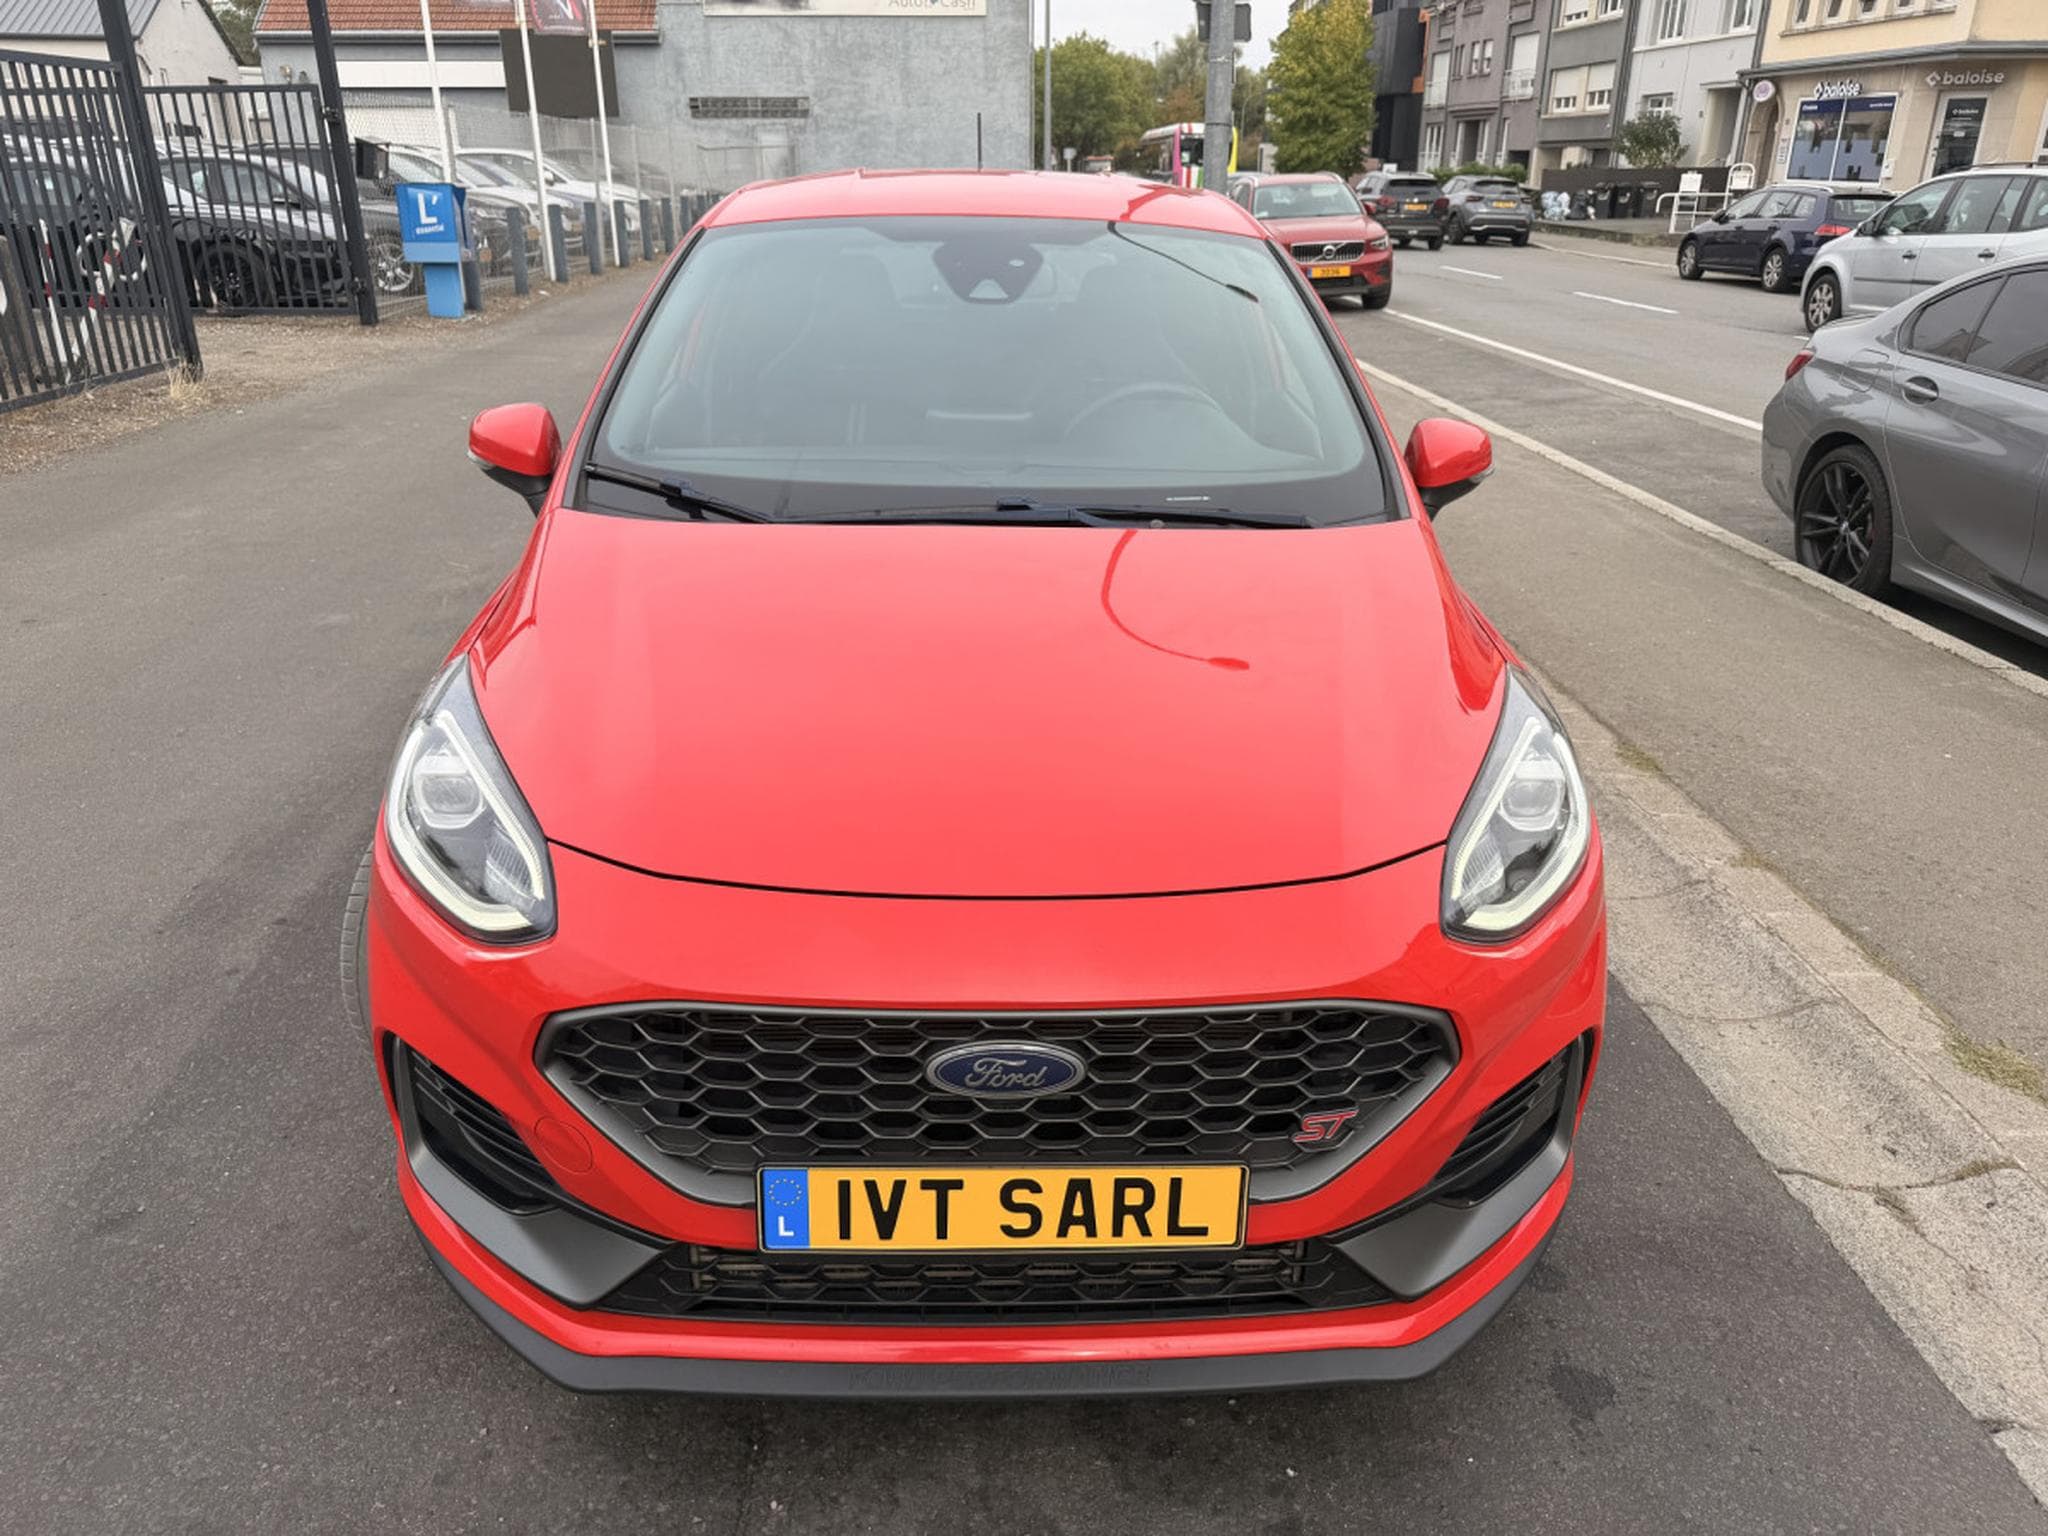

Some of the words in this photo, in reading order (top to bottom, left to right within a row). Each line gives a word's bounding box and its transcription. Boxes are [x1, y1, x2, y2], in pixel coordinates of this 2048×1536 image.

[1943, 69, 2005, 85] baloise
[966, 1057, 1048, 1089] Ford
[1294, 1108, 1360, 1142] ST
[837, 1178, 964, 1241] IVT
[999, 1176, 1210, 1239] SARL
[777, 1215, 795, 1237] L
